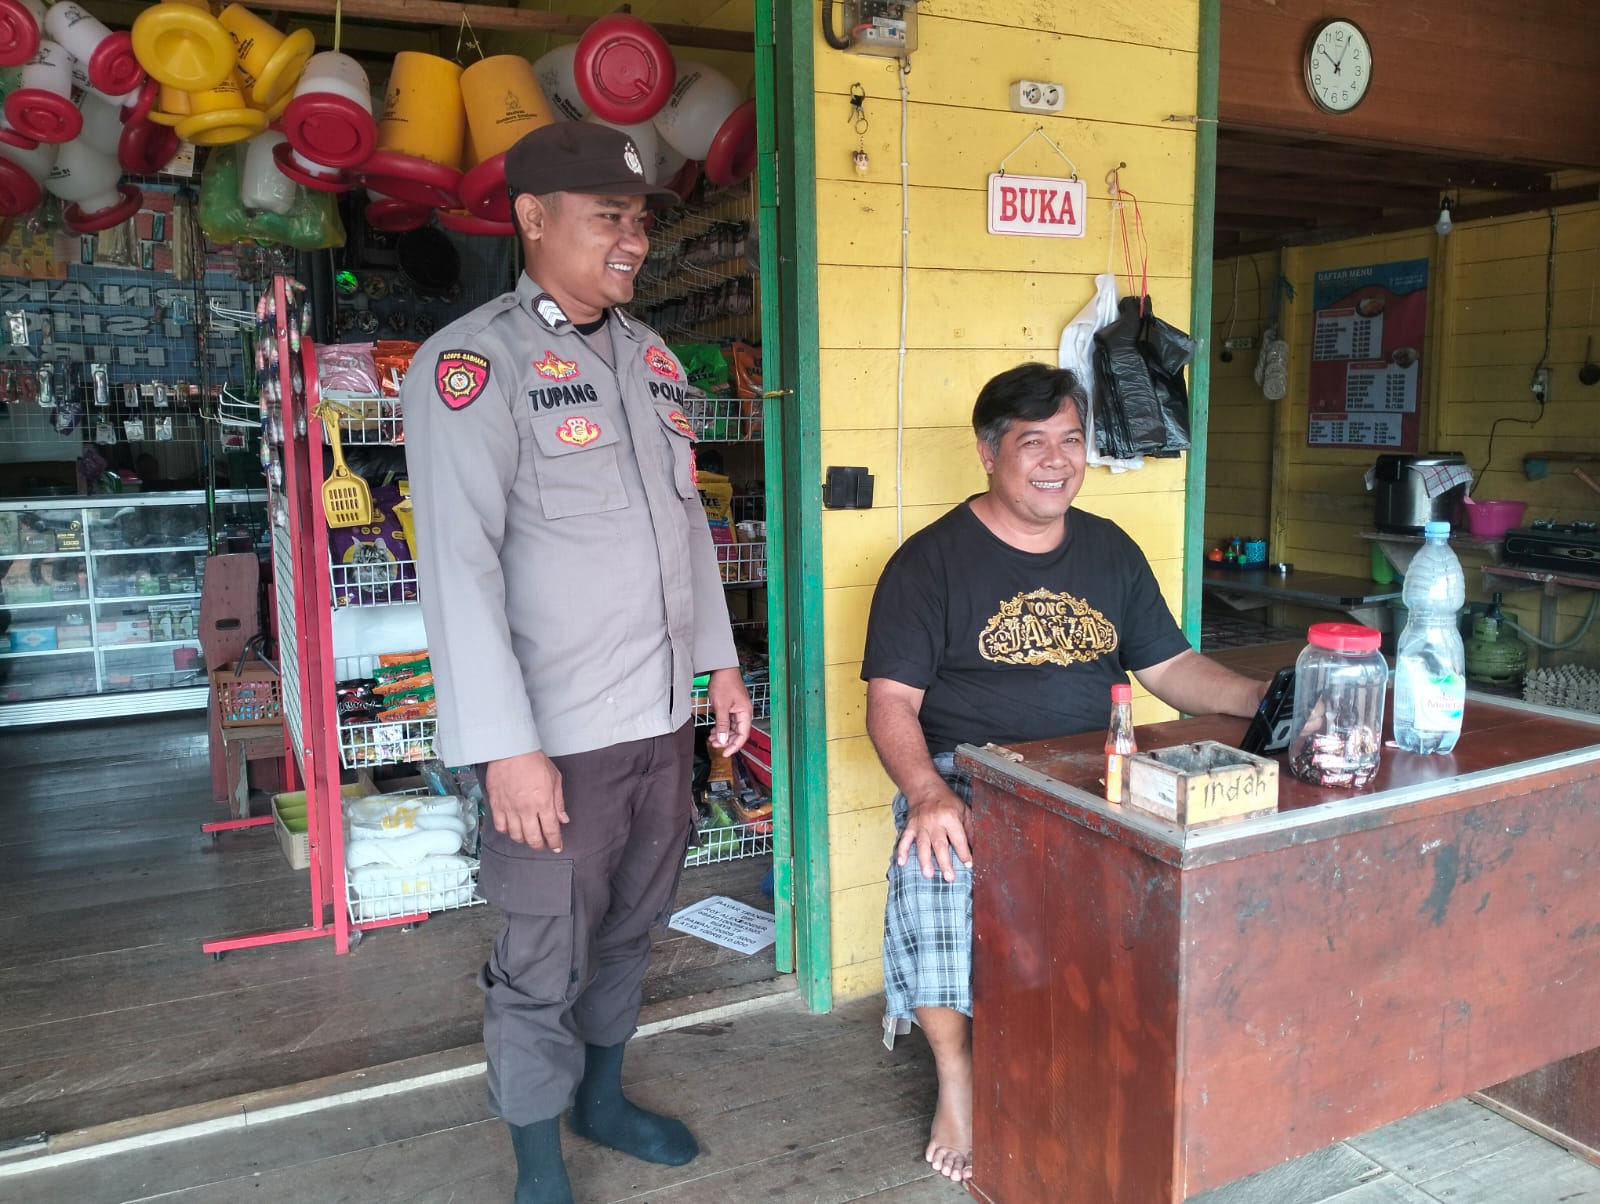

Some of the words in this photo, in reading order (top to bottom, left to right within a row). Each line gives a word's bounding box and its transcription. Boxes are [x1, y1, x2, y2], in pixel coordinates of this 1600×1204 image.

[1325, 32, 1332, 42] 11
[1335, 30, 1343, 42] 12
[1316, 43, 1325, 55] 10
[1353, 49, 1360, 60] 2
[1312, 58, 1319, 69] 9
[1355, 65, 1361, 77] 3
[1314, 74, 1322, 85] 8
[1350, 81, 1357, 90] 4
[1322, 87, 1328, 98] 7
[1331, 92, 1338, 104] 6
[1342, 90, 1348, 101] 5
[1000, 185, 1076, 226] BUKA
[1318, 271, 1348, 281] DAFTAR
[1349, 267, 1373, 278] MENU
[528, 381, 598, 412] TUPANG
[1204, 774, 1266, 808] Indah
